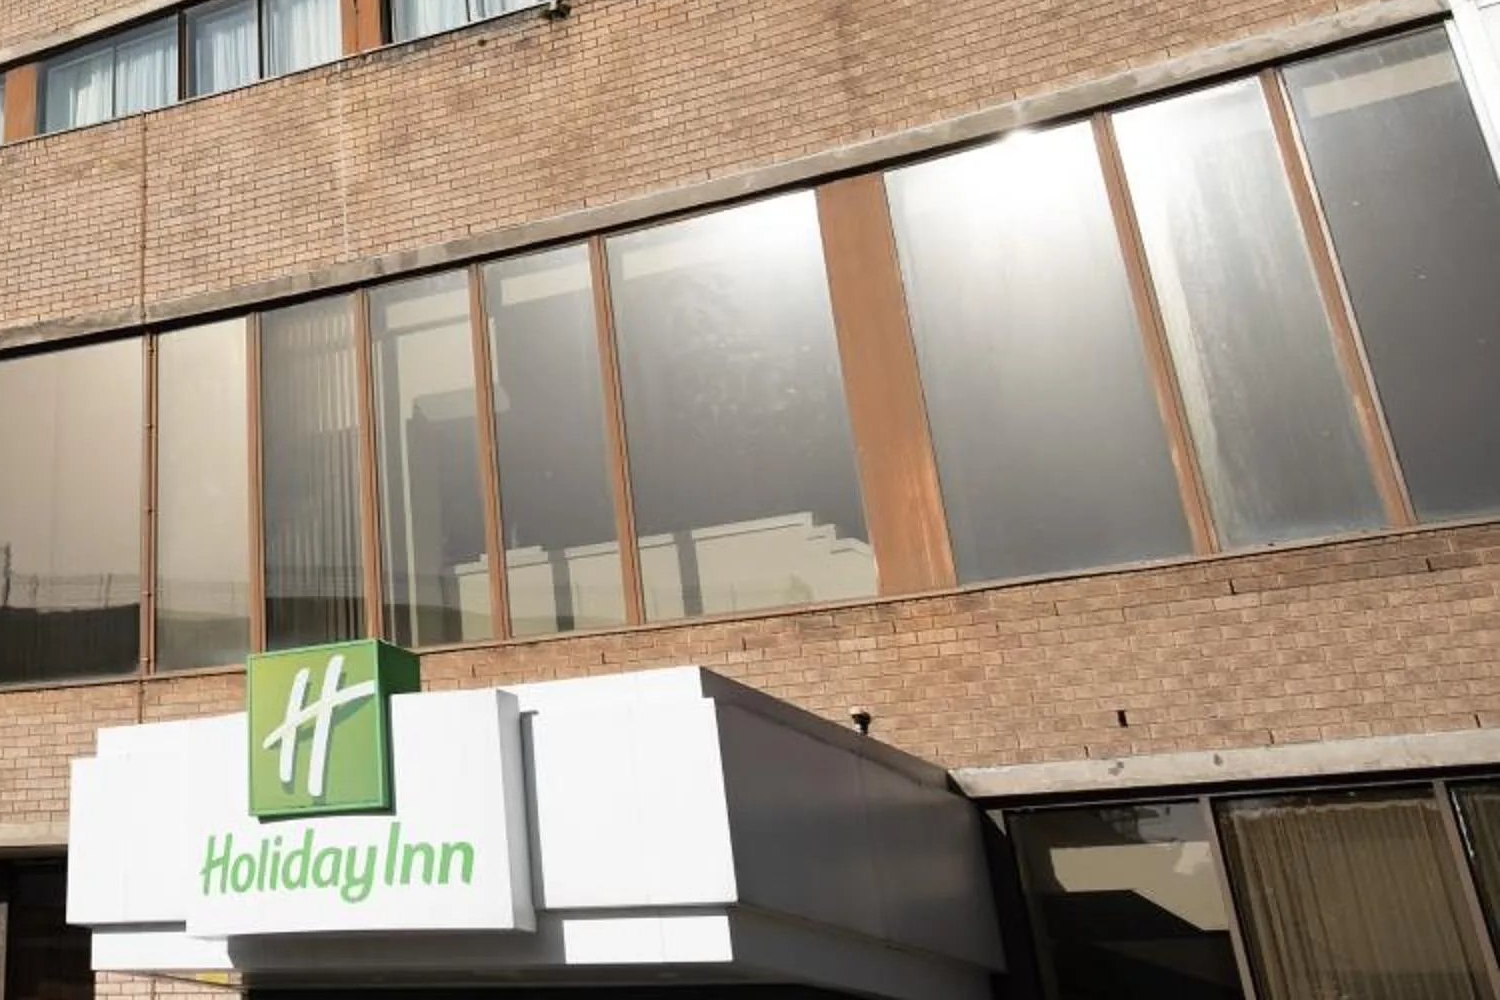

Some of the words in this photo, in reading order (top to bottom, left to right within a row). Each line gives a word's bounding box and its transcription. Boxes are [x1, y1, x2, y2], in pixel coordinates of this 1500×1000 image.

[263, 655, 376, 797] H
[200, 828, 378, 903] Holiday
[384, 822, 475, 886] Inn
